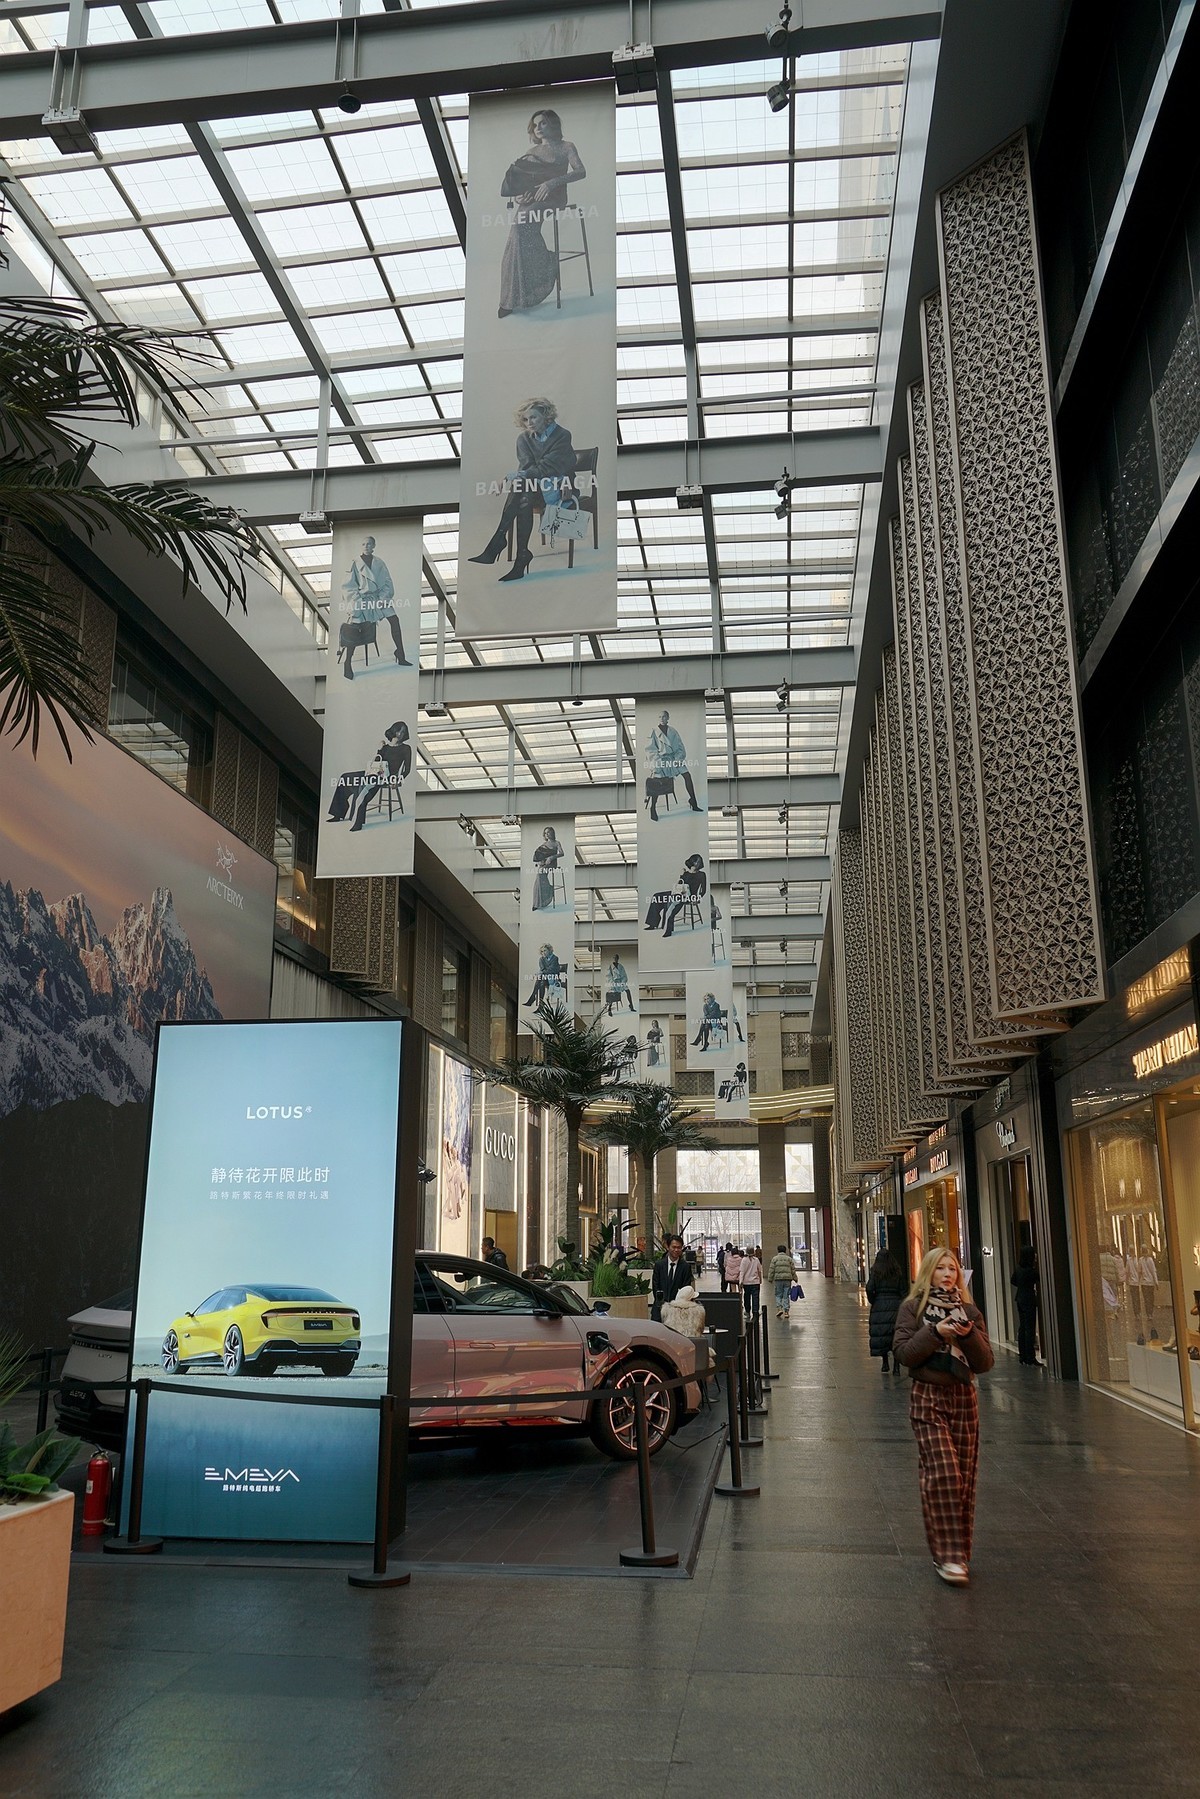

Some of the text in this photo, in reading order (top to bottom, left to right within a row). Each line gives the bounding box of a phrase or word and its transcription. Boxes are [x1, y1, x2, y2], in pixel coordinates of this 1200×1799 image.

[480, 204, 600, 228] BALENCIAGA
[475, 474, 599, 496] BALENCIAGA
[338, 598, 411, 612] BALENCIAGA
[643, 759, 700, 769] BALENCIAGA
[330, 774, 406, 787] BALENCIAGA
[645, 894, 703, 904] BALENCIAGA
[1132, 1042, 1163, 1079] STUART
[246, 1106, 303, 1119] LOTUS
[485, 1126, 518, 1161] GUCC
[211, 1166, 330, 1184] 静待花开限此时
